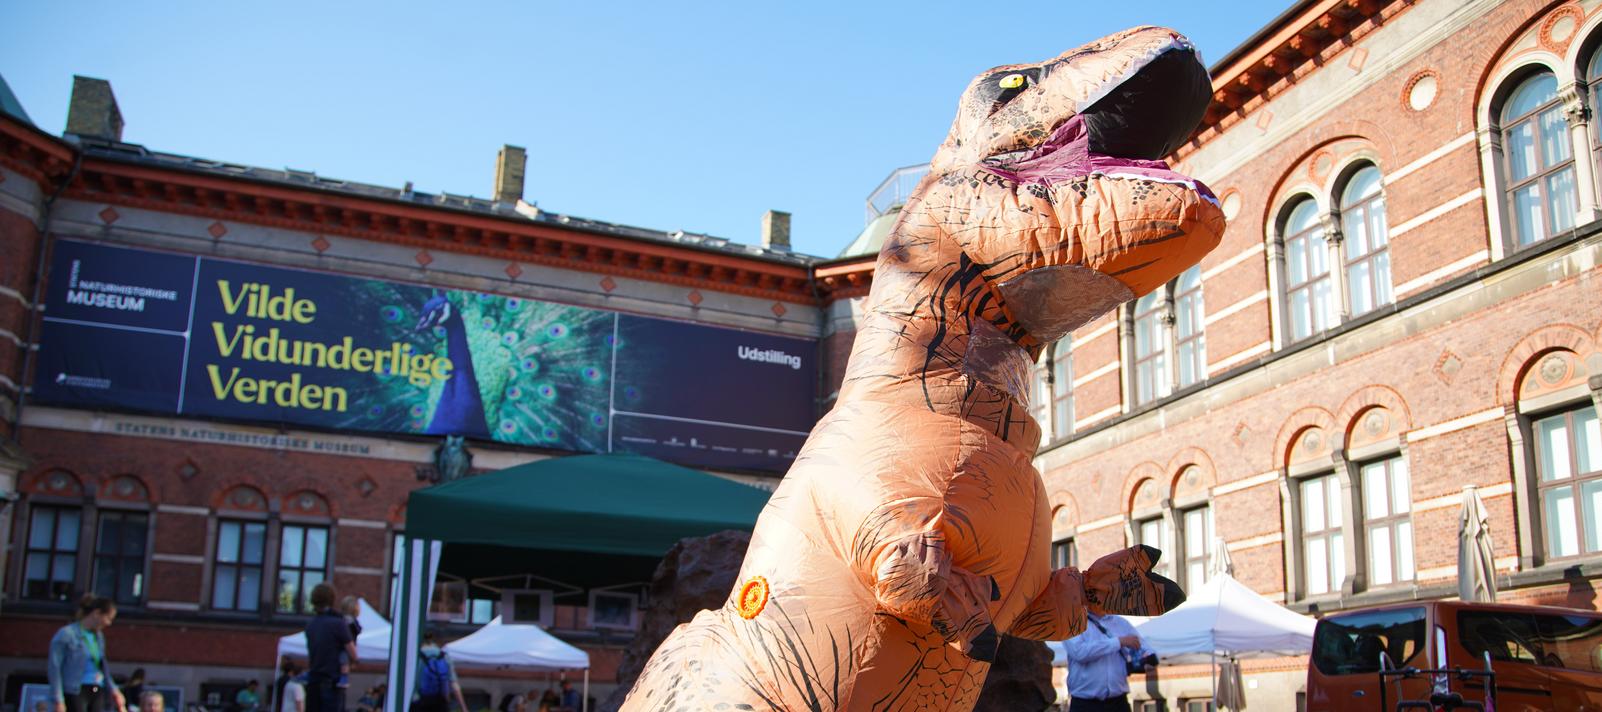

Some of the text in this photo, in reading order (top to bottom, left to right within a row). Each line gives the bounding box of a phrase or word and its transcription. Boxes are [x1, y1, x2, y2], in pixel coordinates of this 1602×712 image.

[66, 289, 145, 312] MUSEUM
[217, 279, 317, 324] Vilde
[211, 321, 454, 387] Vidunderlige
[738, 345, 802, 370] Udstilling
[206, 364, 348, 412] Verden
[313, 440, 370, 454] MUSEUM
